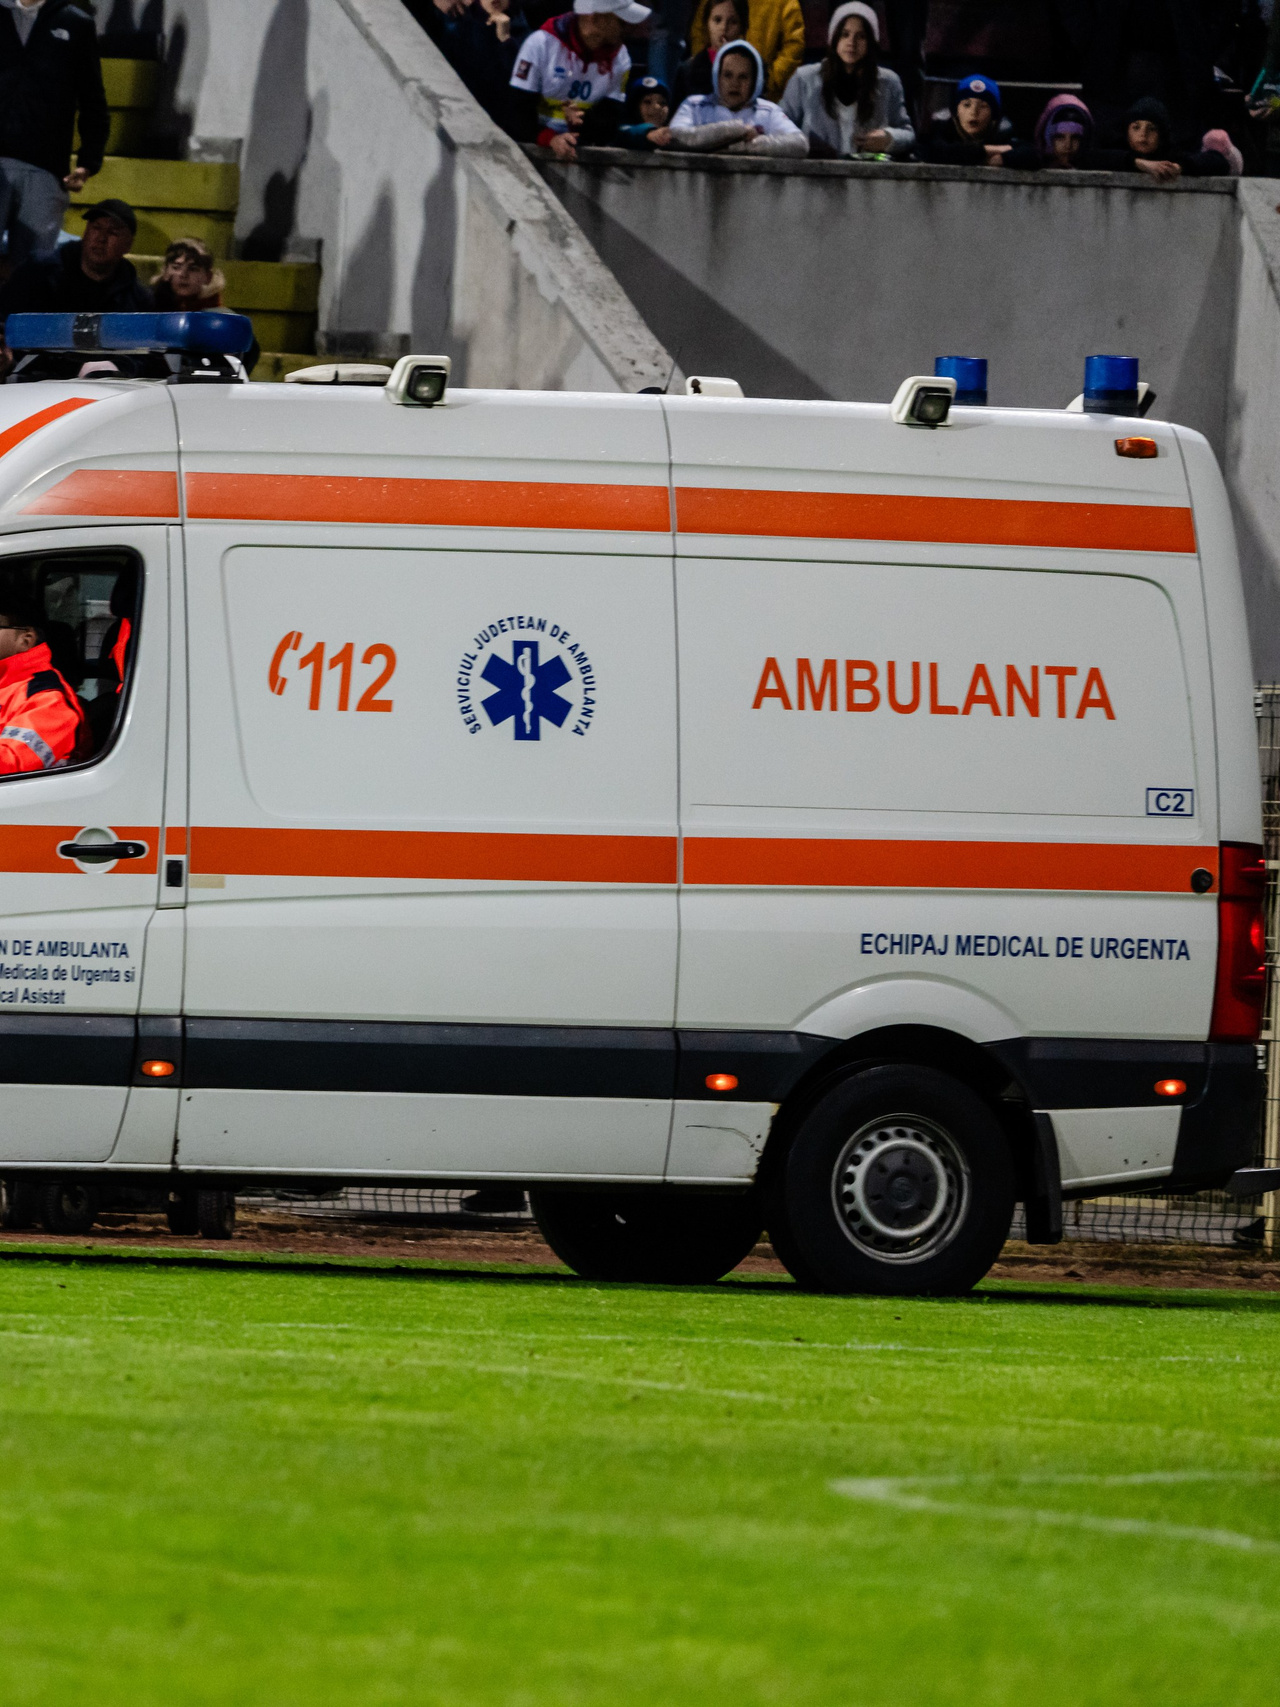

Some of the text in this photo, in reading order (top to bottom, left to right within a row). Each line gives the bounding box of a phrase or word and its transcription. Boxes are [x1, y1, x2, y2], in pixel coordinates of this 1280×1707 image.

[298, 641, 397, 712] 112
[457, 615, 597, 737] SERVICIUL JUDETEAN DE AMBULANTA
[751, 656, 1117, 721] AMBULANTA
[1154, 791, 1186, 813] C2
[11, 939, 33, 957] DE
[35, 940, 130, 959] AMBULANTA
[859, 933, 1191, 961] ECHIPAJ MEDICAL DE URGENTA
[52, 964, 68, 981] de
[70, 965, 120, 986] Urgenta
[122, 966, 136, 984] si
[21, 986, 67, 1005] Asistat
